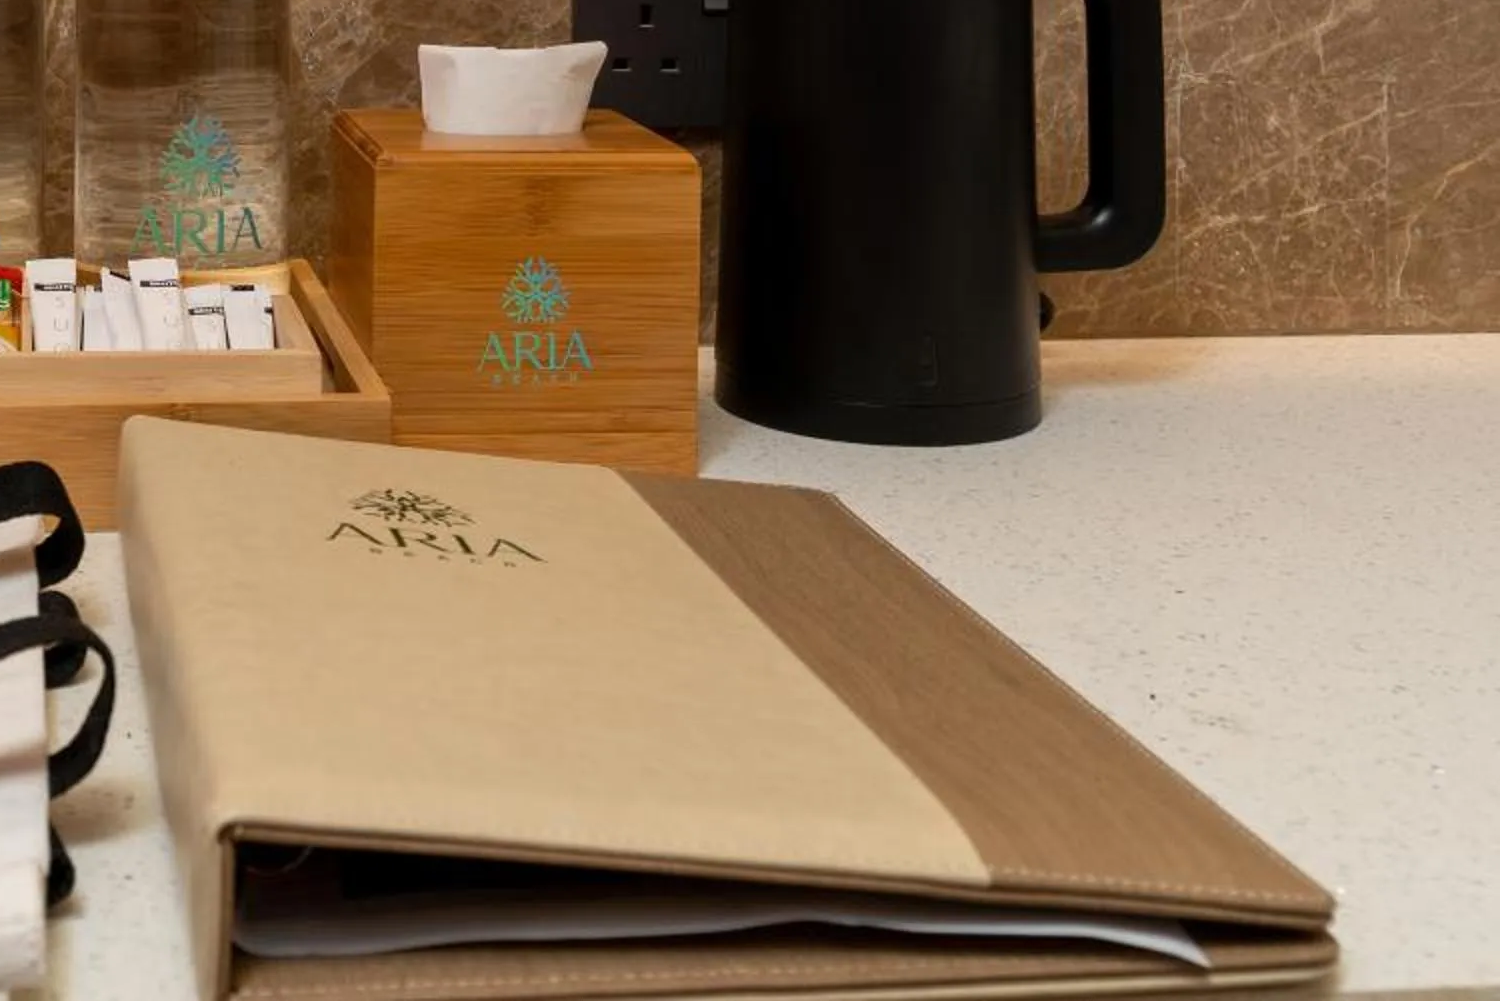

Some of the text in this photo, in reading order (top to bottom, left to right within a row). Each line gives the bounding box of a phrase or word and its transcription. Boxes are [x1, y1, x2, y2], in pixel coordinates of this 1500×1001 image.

[130, 205, 264, 256] ARIA
[476, 330, 593, 371] ARIA
[326, 521, 548, 563] ARIA
